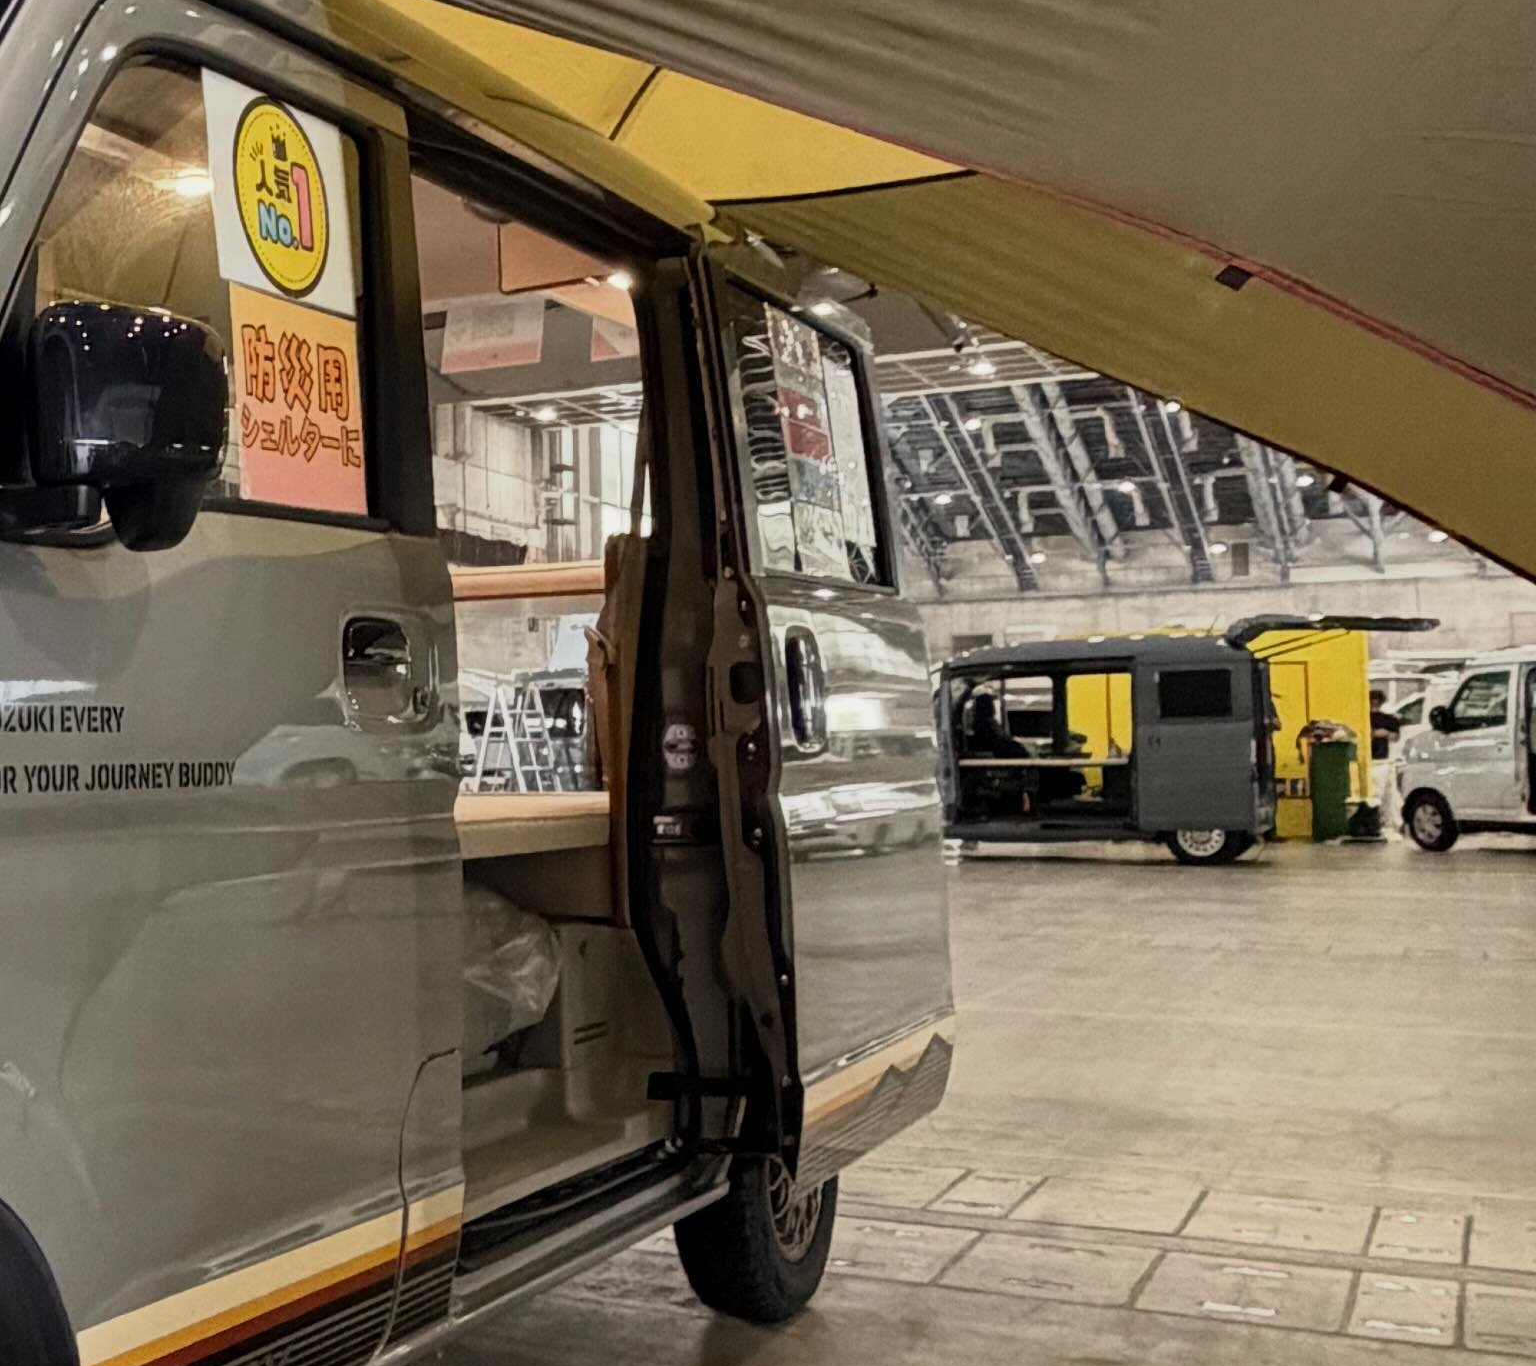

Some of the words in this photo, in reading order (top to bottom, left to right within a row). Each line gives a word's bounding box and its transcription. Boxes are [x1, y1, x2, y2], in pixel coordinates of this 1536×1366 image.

[241, 324, 349, 421] 防災用
[241, 403, 361, 468] シェルターに
[60, 706, 125, 733] EVERY
[23, 764, 80, 793] YOUR
[84, 762, 174, 791] JOURNEY
[178, 760, 236, 787] BUDDY
